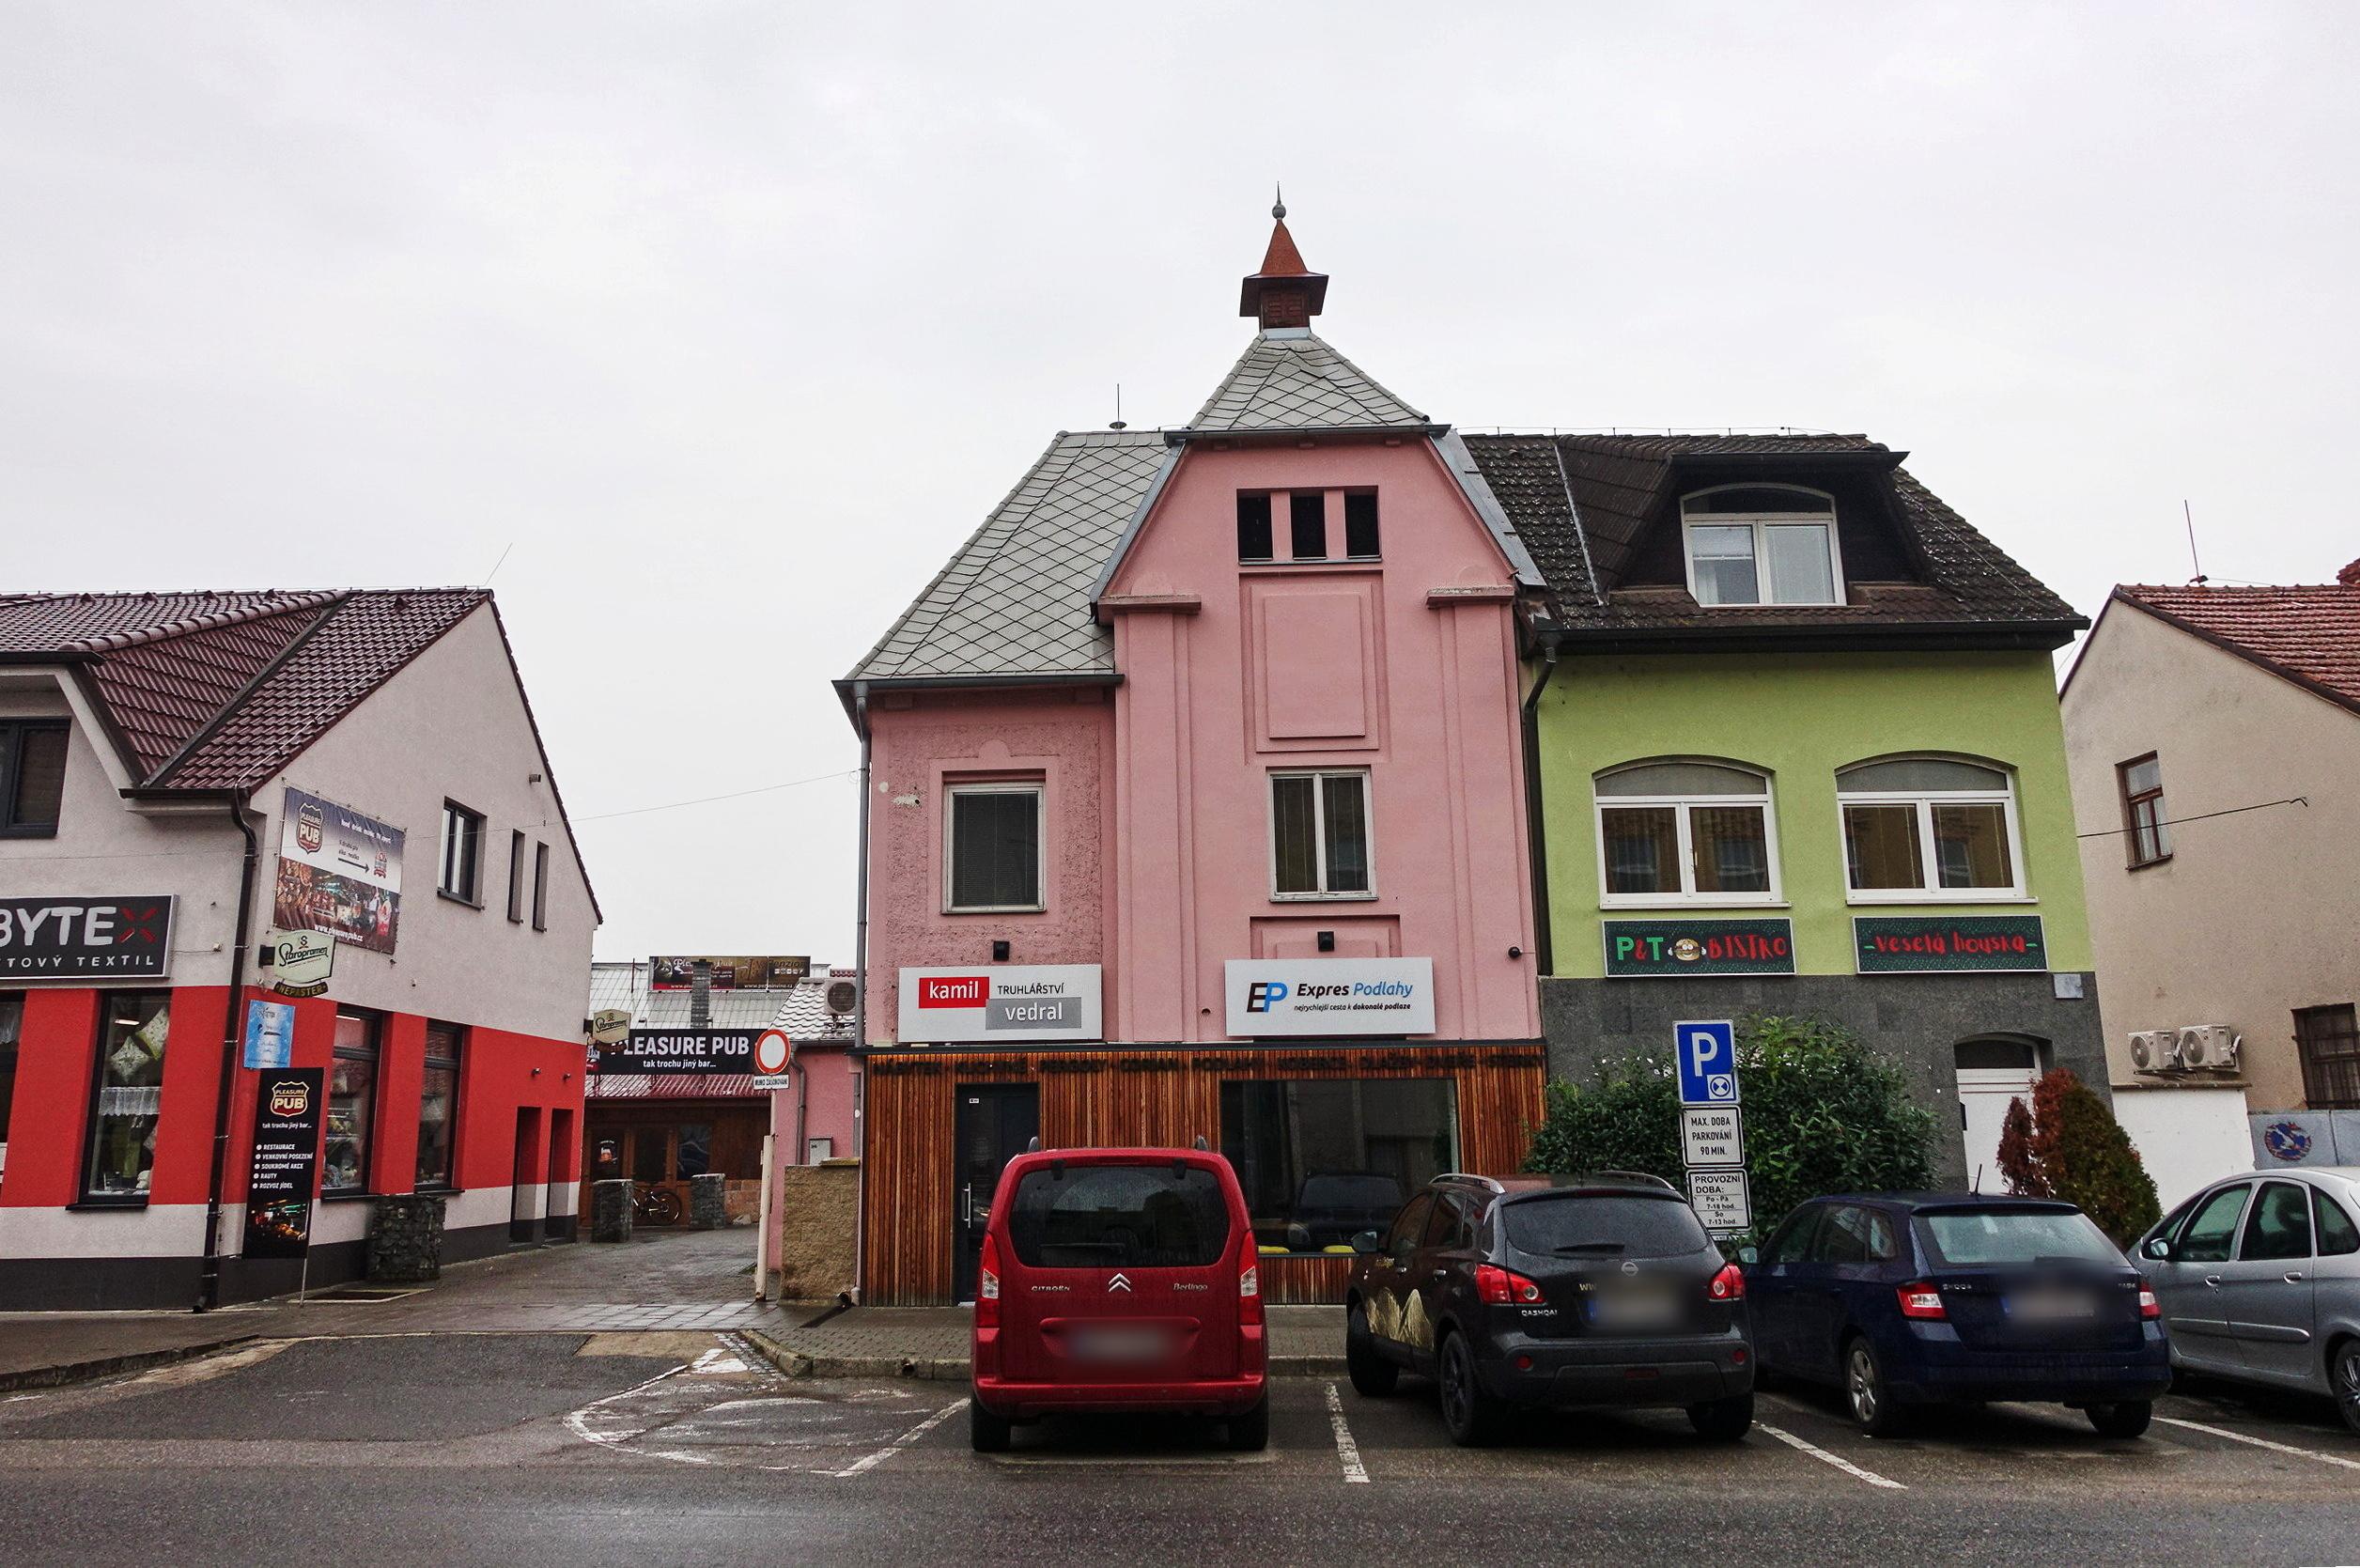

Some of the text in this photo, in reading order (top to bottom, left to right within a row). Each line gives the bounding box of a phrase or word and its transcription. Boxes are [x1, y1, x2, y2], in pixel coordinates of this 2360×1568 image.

[300, 823, 320, 844] PUB
[1615, 933, 1787, 961] P&T BISTRO
[278, 942, 329, 967] Staropramen
[0, 955, 154, 968] TOVÝ TEXTIL
[929, 980, 979, 1000] kamil
[997, 982, 1064, 996] TRUHLÁŘSTVÍ
[1296, 980, 1414, 1000] Expres Podlahy
[1246, 982, 1288, 1013] EP
[1004, 1001, 1063, 1021] vedral
[1294, 1002, 1329, 1014] nejrychlejší
[1353, 1002, 1384, 1011] dokonalé
[1384, 1002, 1411, 1012] podlaze
[611, 1036, 706, 1055] LEASURE
[711, 1036, 750, 1055] PUB
[1691, 1032, 1718, 1078] P
[682, 1060, 697, 1069] jiný
[273, 1097, 304, 1110] PUB
[1691, 1117, 1731, 1126] MAX. DOBA
[1692, 1130, 1732, 1141] PARKOVÁNÍ
[262, 1152, 314, 1160] VENKOVNÍ POSEZENÍ
[1700, 1146, 1727, 1156] 90 MIN.
[279, 1181, 294, 1190] JÍDEL
[1695, 1186, 1724, 1194] DOBA:
[1031, 1284, 1070, 1293] CITROËN
[1172, 1282, 1208, 1293] Berlingo
